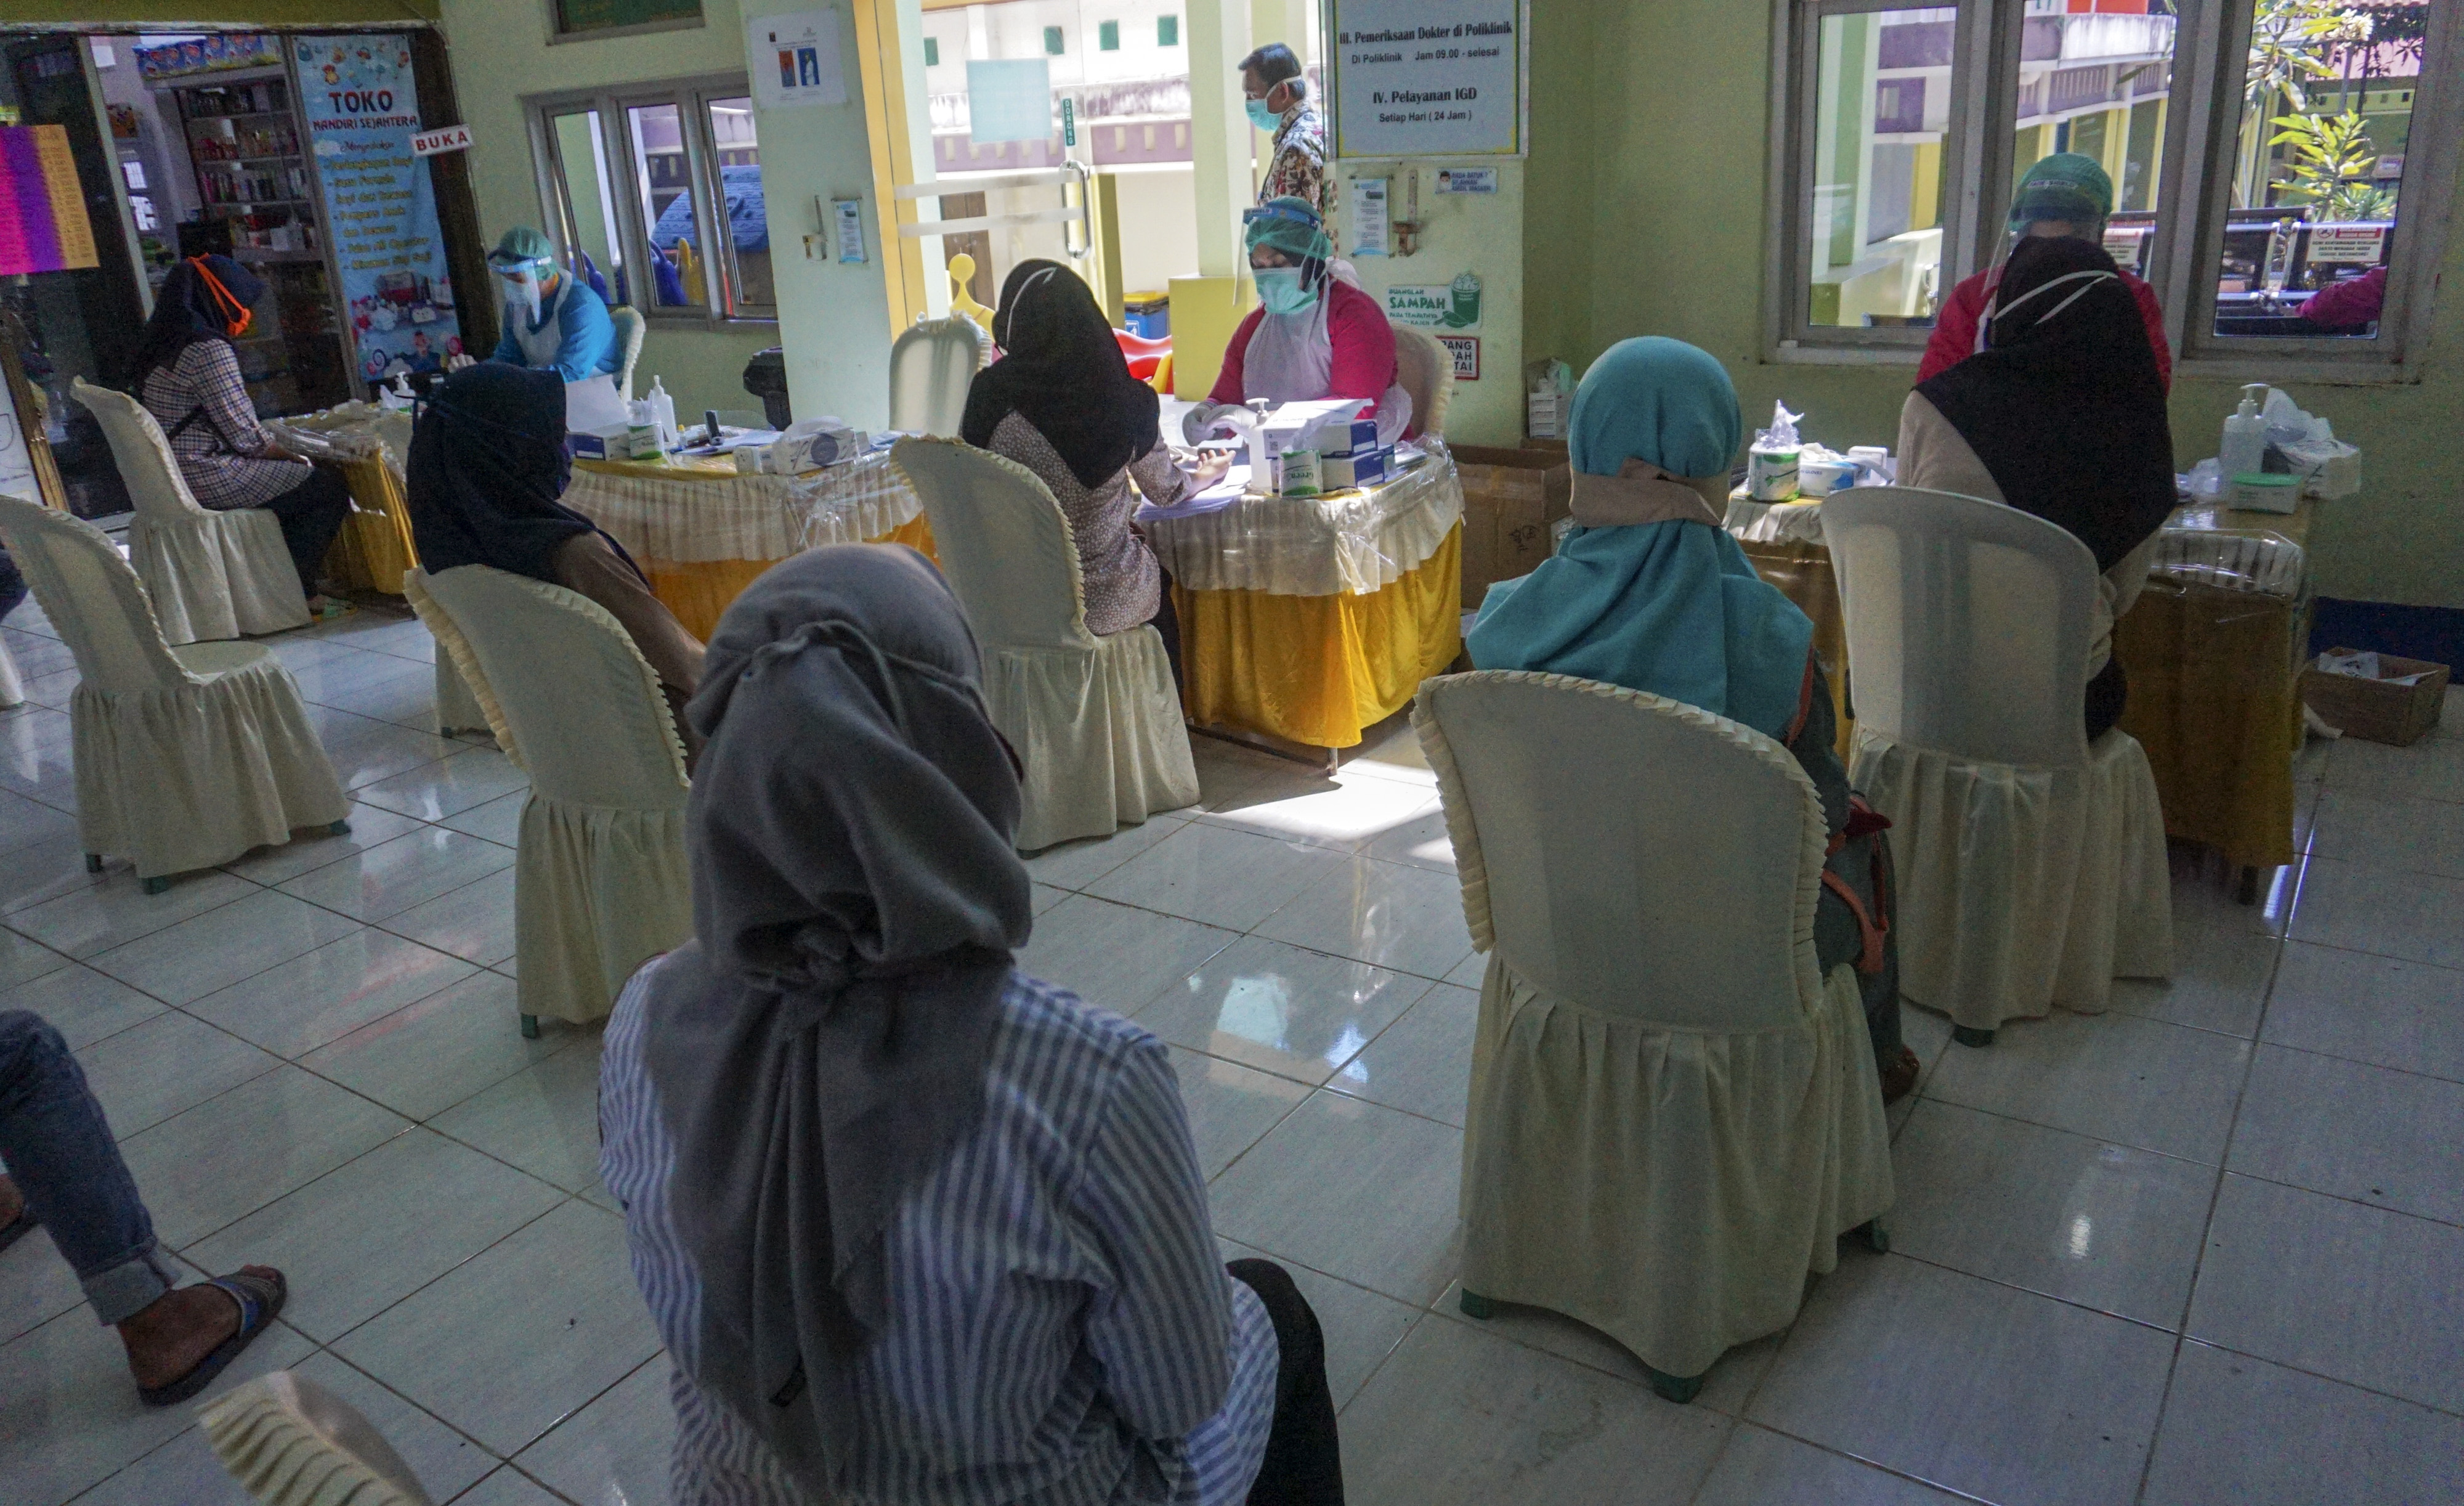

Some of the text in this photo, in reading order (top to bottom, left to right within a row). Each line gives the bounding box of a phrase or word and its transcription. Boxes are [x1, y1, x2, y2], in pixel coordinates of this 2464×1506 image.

[1339, 21, 1513, 44] III. Pemeriksaan Dokter di Poliklinik
[1352, 54, 1361, 64] Di
[1363, 52, 1403, 63] Poliklinik
[1415, 51, 1433, 61] Jam
[1435, 48, 1459, 59] 09.00
[1467, 46, 1500, 58] selesai
[328, 90, 393, 113] TOKO
[1373, 87, 1477, 105] IV. Pelayanan IGD
[312, 115, 418, 131] MANDIRI SEJAHTERA
[1065, 100, 1073, 144] DORONG
[1379, 113, 1406, 123] Setiap
[1409, 111, 1426, 121] Hari
[1434, 110, 1445, 120] 24
[1447, 110, 1466, 120] Jam
[415, 130, 468, 152] BUKA
[1388, 296, 1446, 309] SAMPAH
